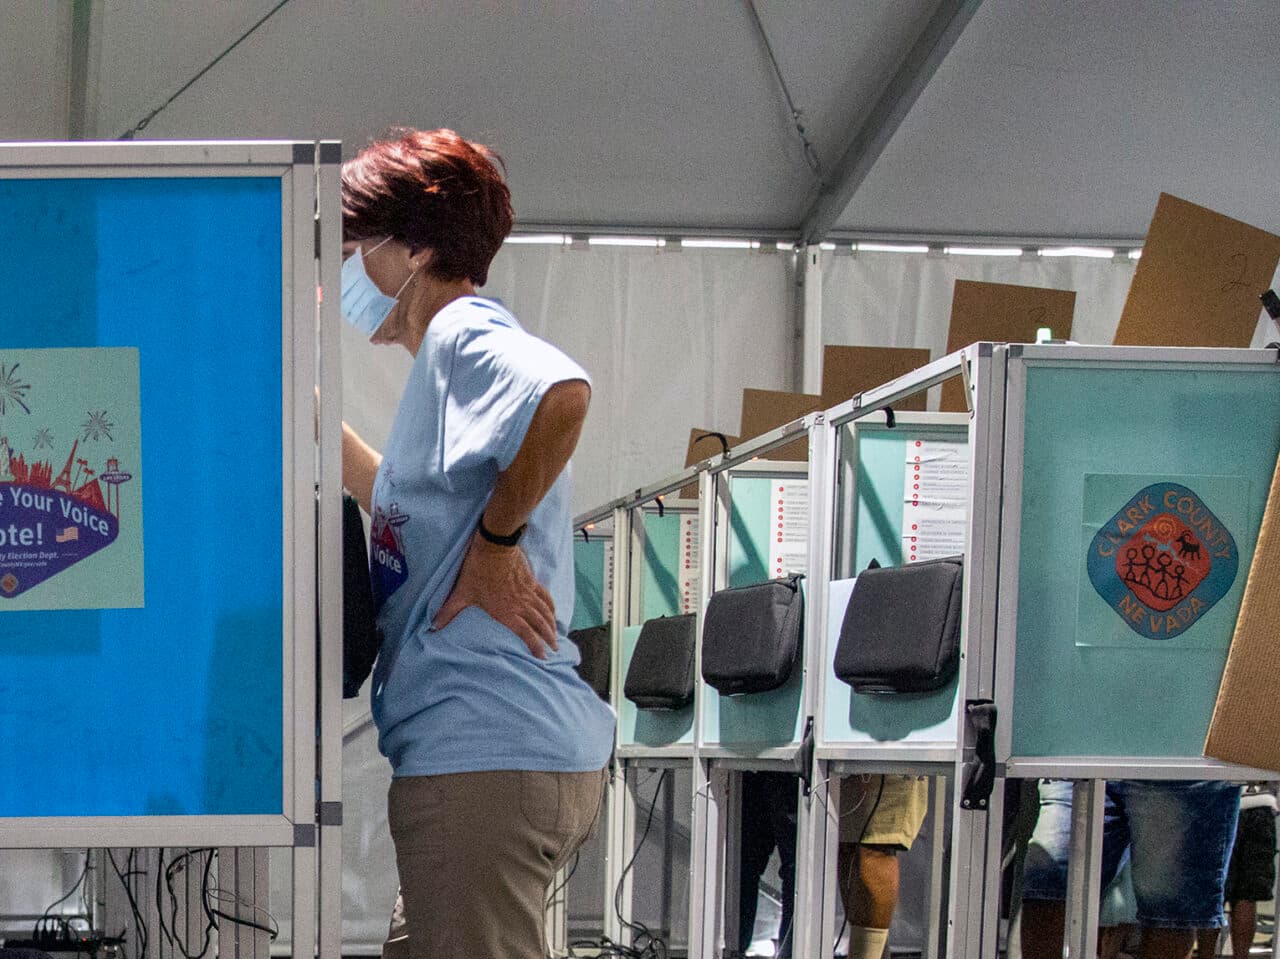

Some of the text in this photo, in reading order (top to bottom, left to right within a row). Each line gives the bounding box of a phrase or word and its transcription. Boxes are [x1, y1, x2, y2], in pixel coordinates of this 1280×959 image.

[9, 486, 53, 512] Your
[59, 497, 109, 537] Voice
[1097, 490, 1232, 559] CLARK COUNTY
[7, 551, 38, 560] Election
[39, 551, 60, 561] Dept.
[1118, 594, 1206, 635] NEVADA
